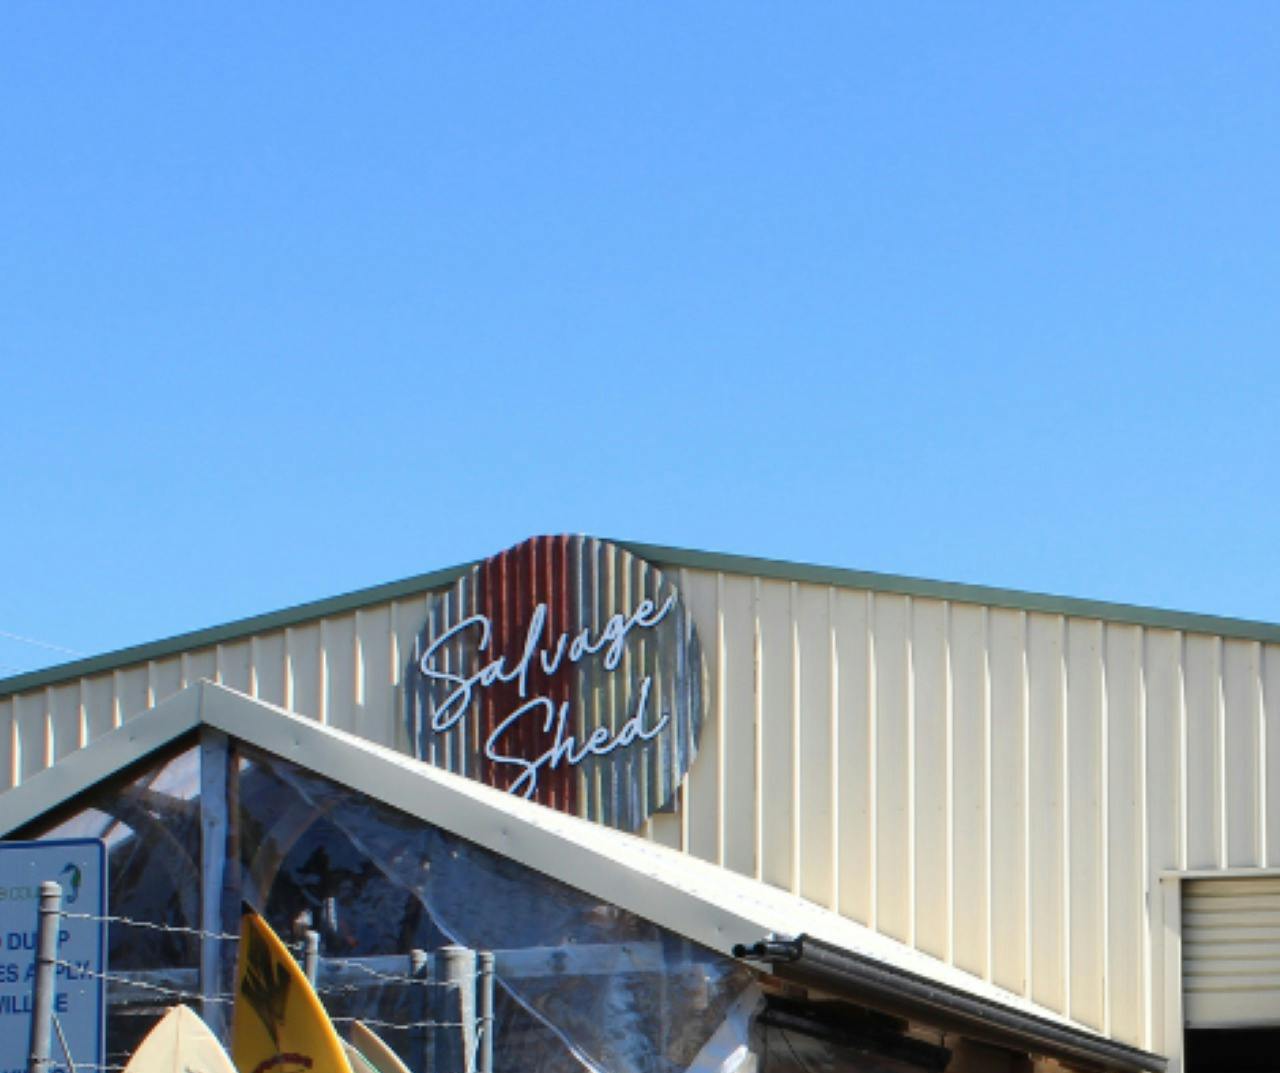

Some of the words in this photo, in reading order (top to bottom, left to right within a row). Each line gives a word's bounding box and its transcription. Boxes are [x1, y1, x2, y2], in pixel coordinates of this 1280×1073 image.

[420, 595, 677, 732] Salvage
[485, 675, 669, 799] Shed
[8, 930, 70, 950] DUP
